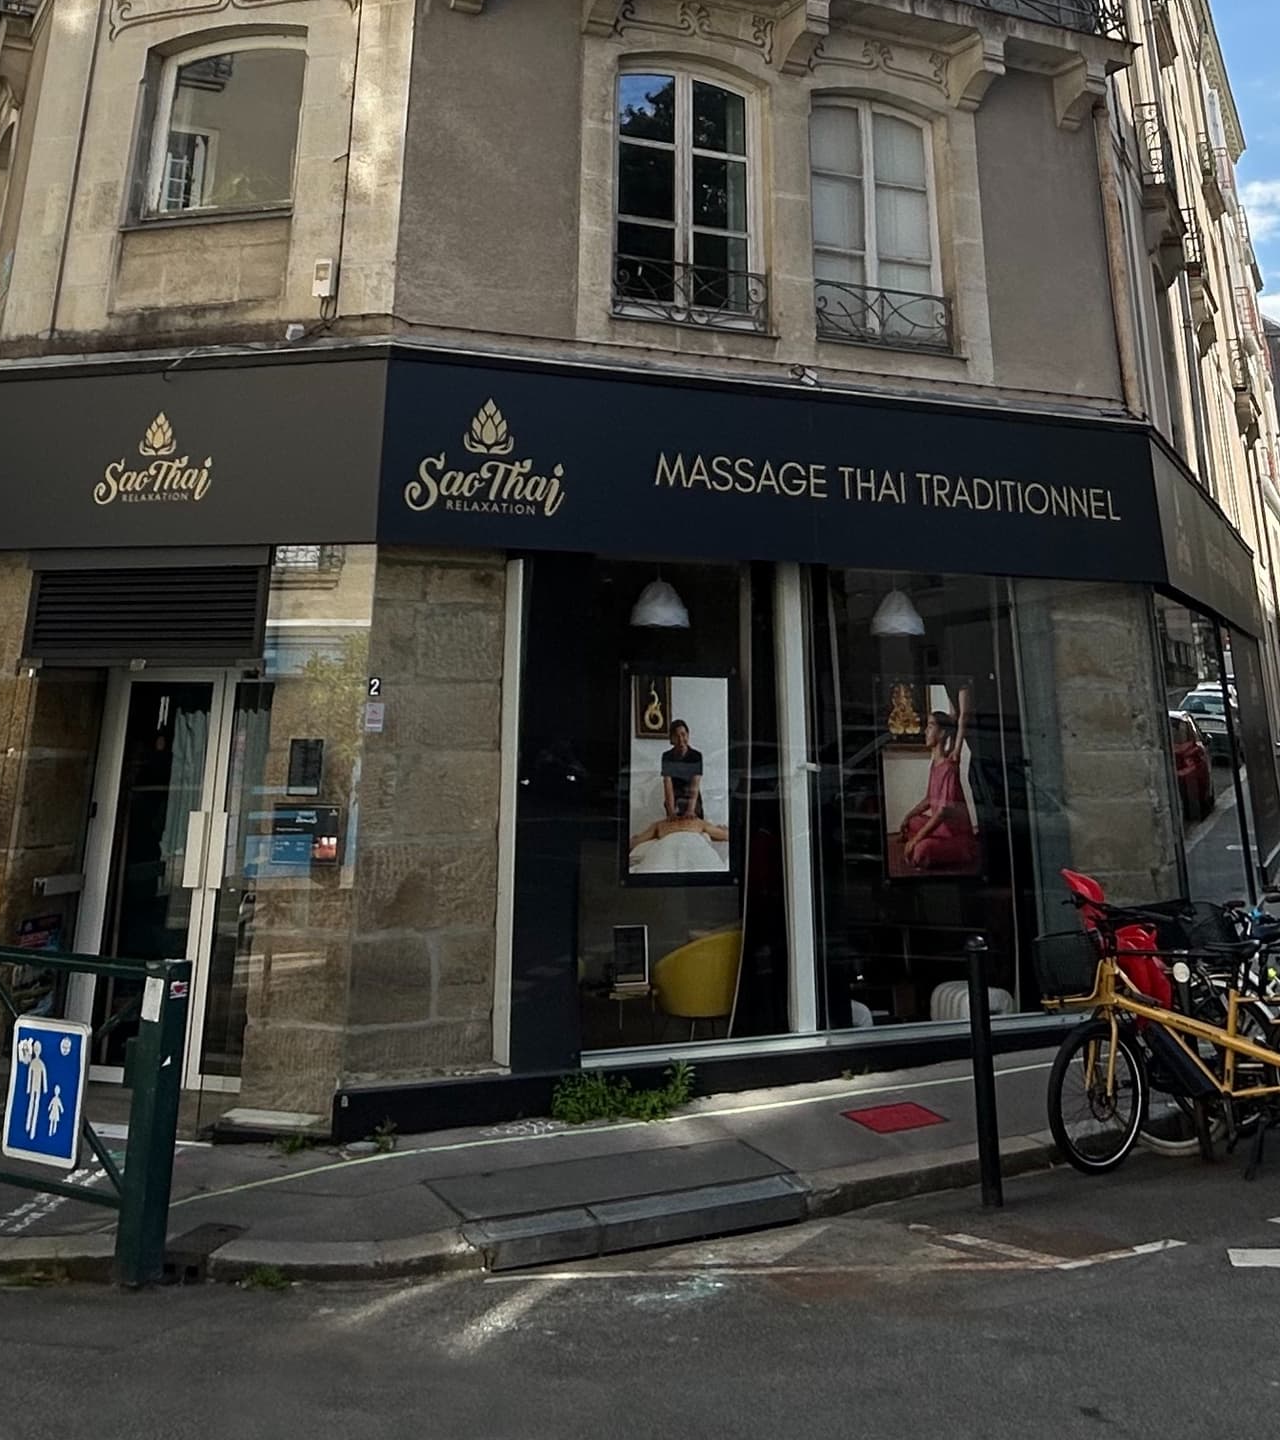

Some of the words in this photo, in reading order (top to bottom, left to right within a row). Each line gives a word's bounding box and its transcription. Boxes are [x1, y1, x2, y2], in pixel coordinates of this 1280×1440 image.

[655, 451, 828, 499] MASSAGE
[838, 466, 907, 505] THAI
[915, 472, 1122, 521] TRADITIONNEL
[121, 491, 190, 504] RELAXATION
[445, 499, 537, 516] RELAXATION
[370, 678, 380, 696] 2
